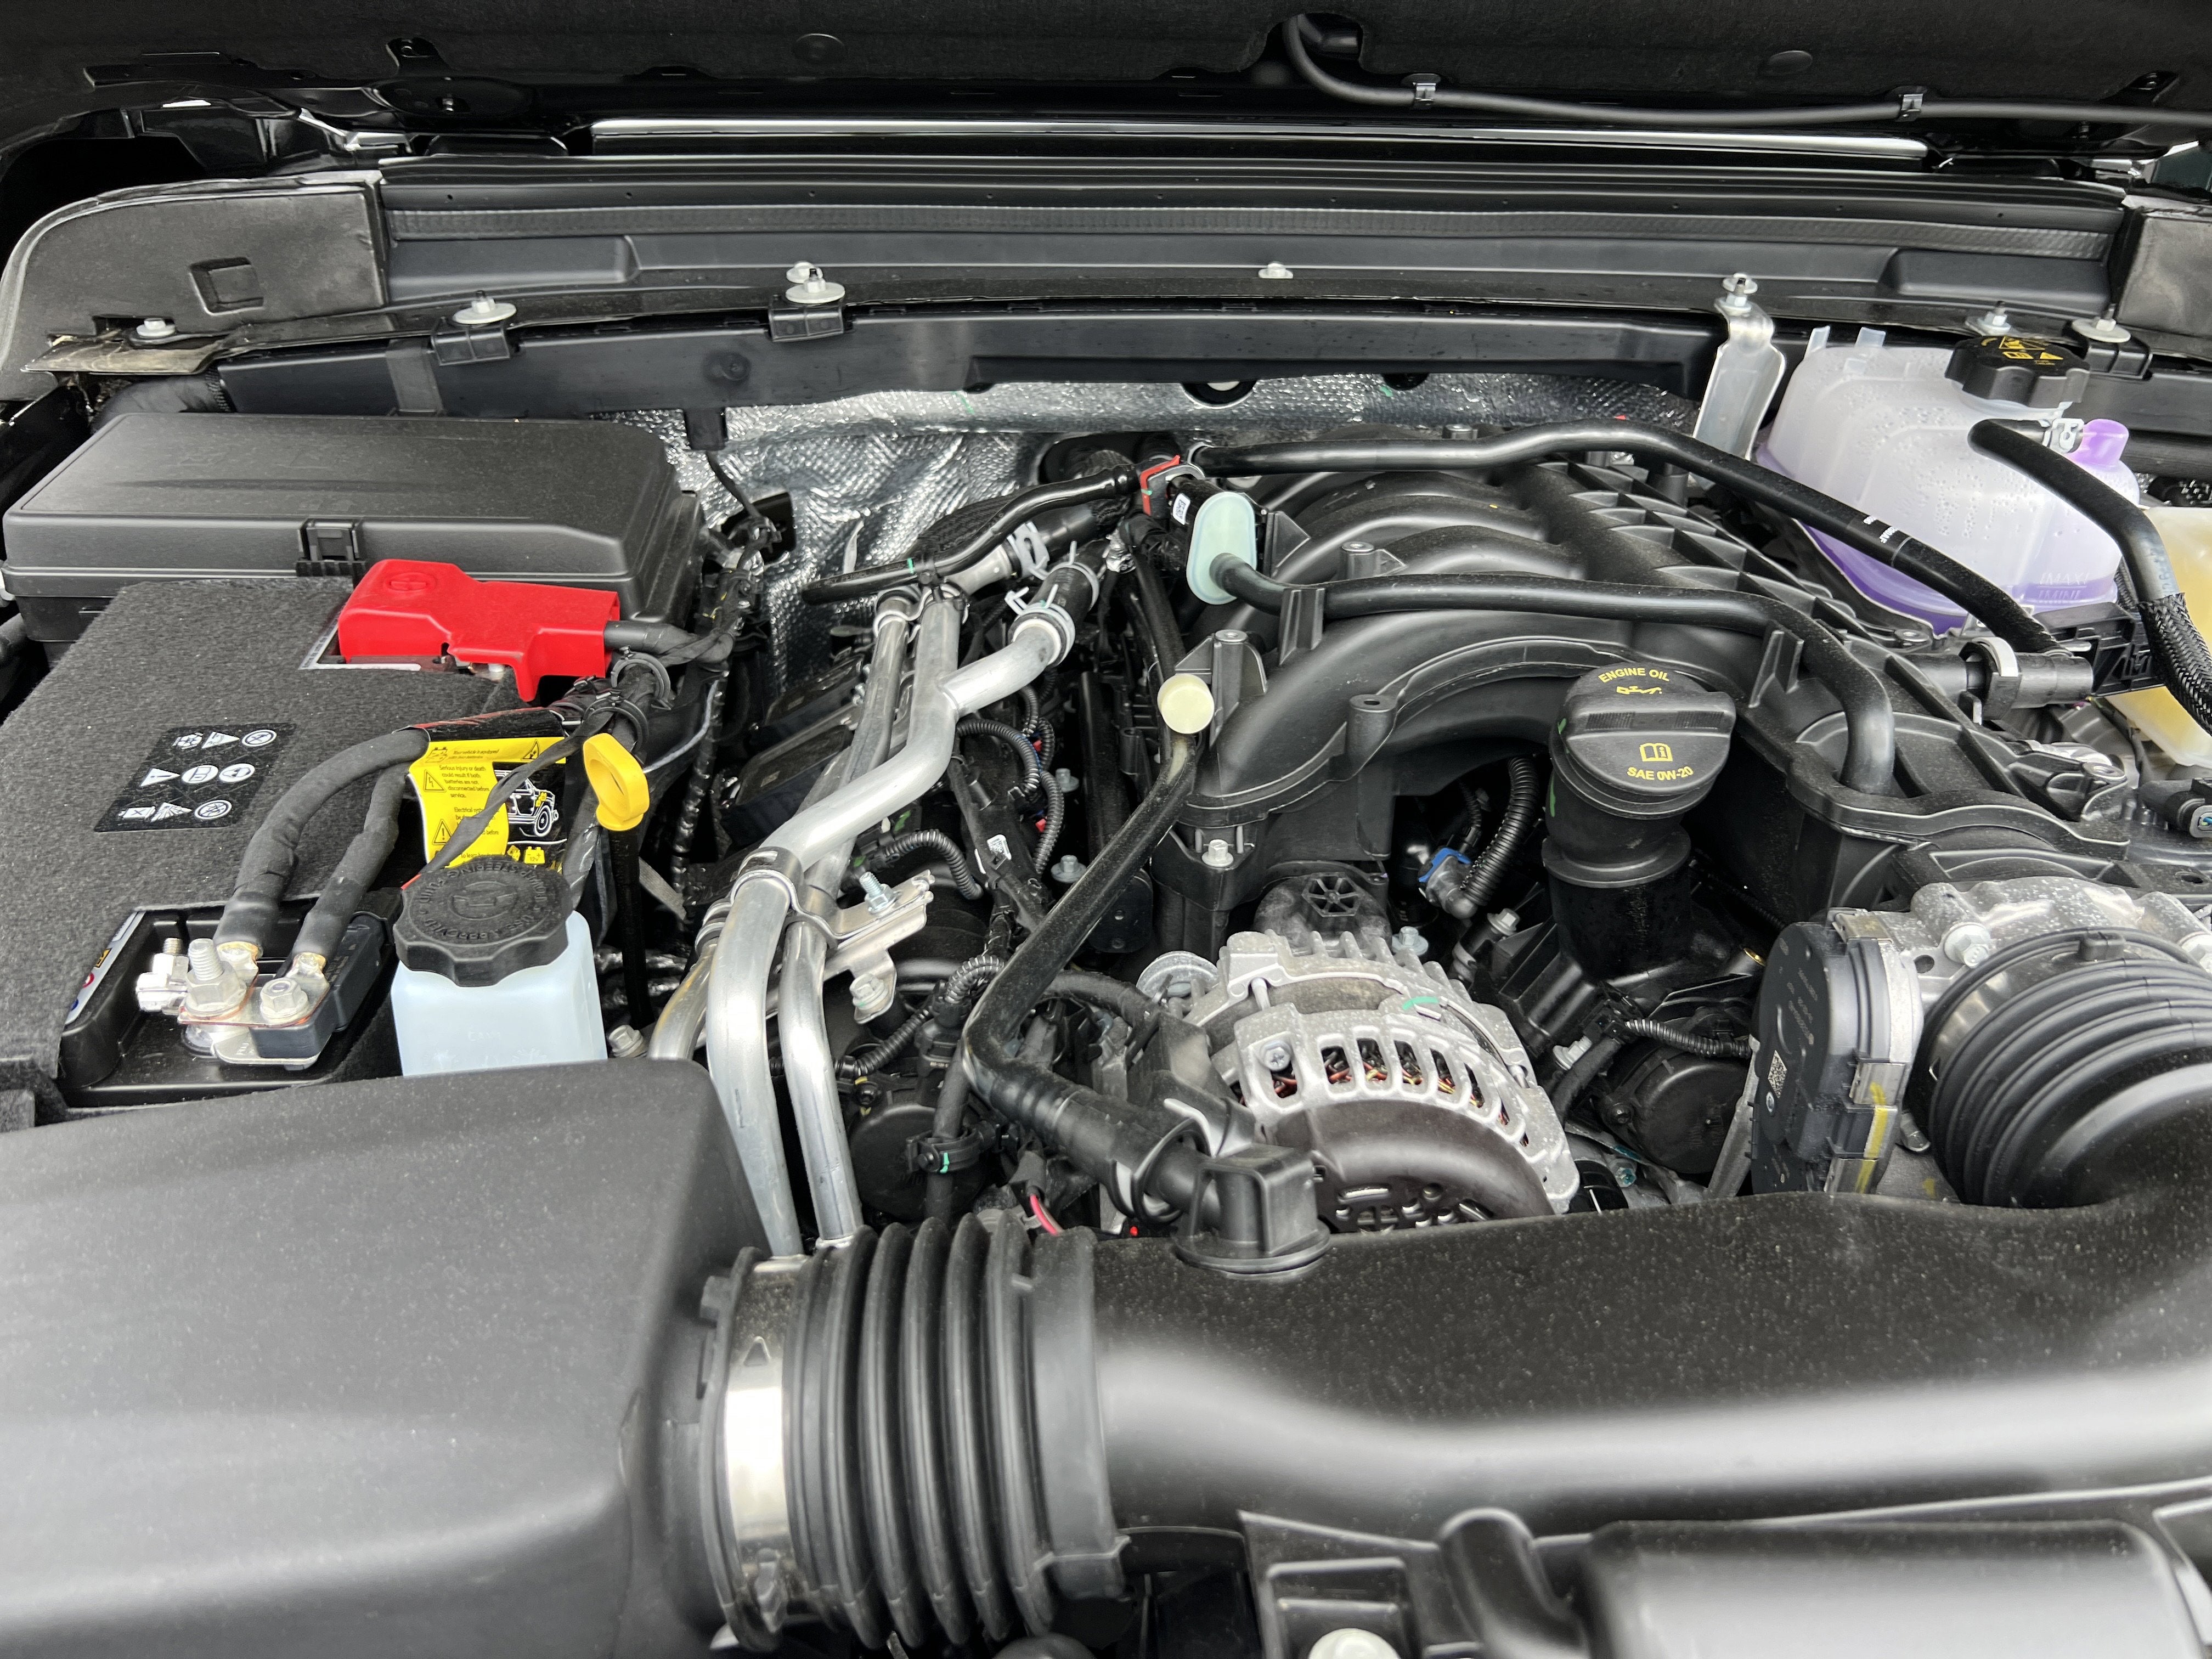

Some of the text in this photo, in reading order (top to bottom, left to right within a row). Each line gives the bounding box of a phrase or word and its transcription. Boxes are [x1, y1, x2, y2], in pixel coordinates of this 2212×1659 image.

[1598, 668, 1669, 683] ENGINE OIL
[1627, 766, 1694, 781] SAE 0W-20
